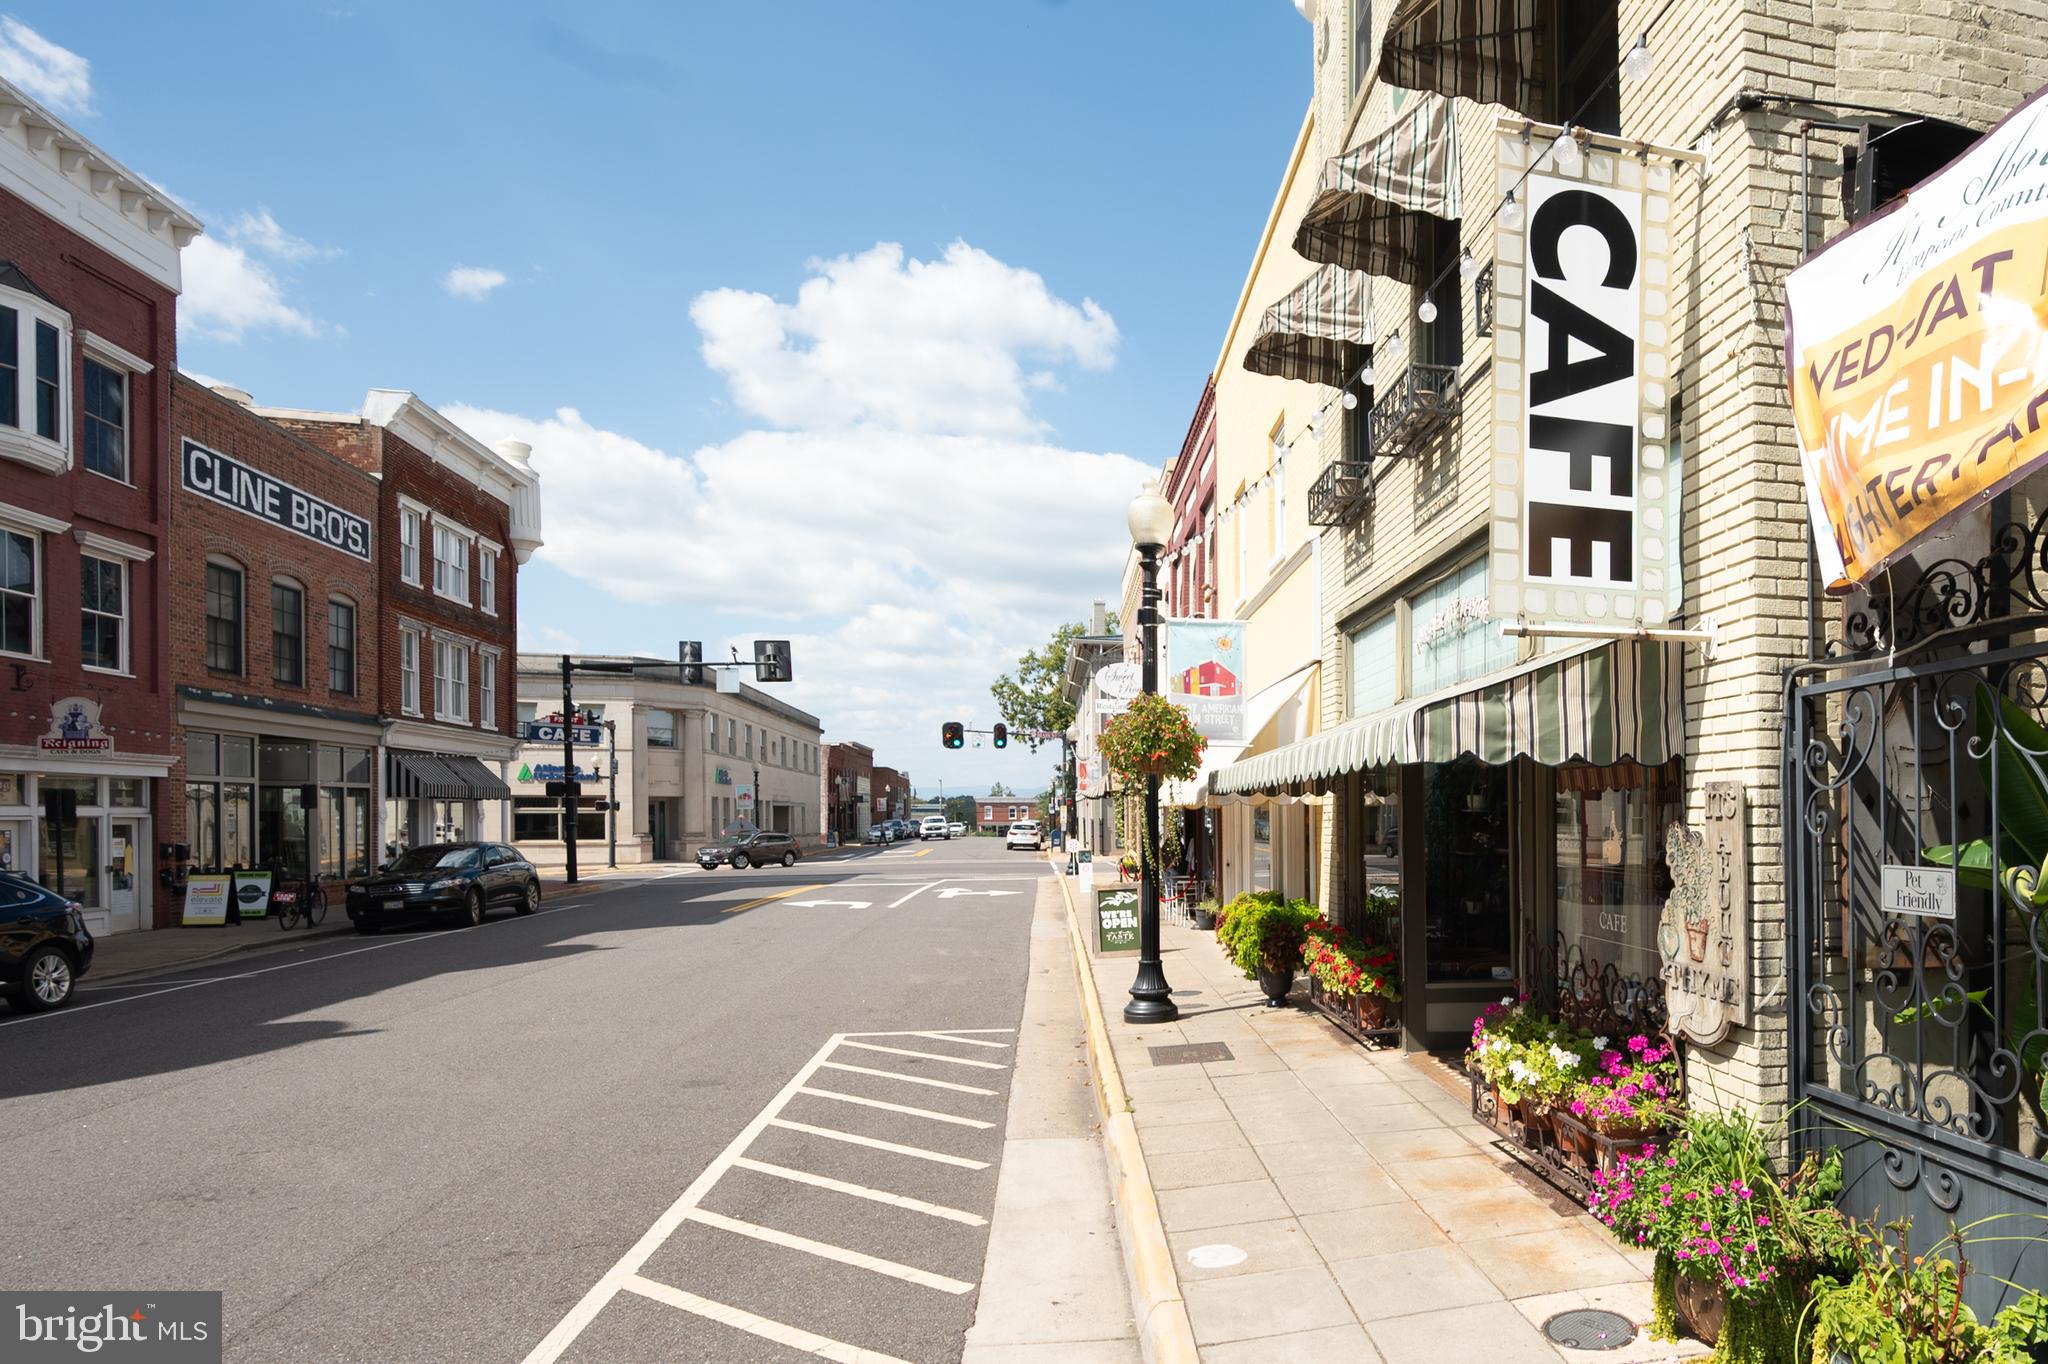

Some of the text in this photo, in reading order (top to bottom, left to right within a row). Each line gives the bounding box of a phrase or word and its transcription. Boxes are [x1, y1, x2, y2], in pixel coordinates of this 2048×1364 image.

[1528, 189, 1638, 583] CAFE
[190, 450, 280, 520] CLINE
[1204, 714, 1235, 725] STREET
[538, 727, 592, 742] CAFE
[43, 738, 109, 749] Reigning
[1905, 871, 1926, 889] Pet
[1896, 890, 1942, 914] Friendly
[1100, 909, 1132, 919] WE'RE
[1102, 917, 1138, 929] OPEN
[1599, 911, 1628, 934] CAFE
[1106, 933, 1135, 941] TASTE
[1666, 964, 1740, 1006] THYME
